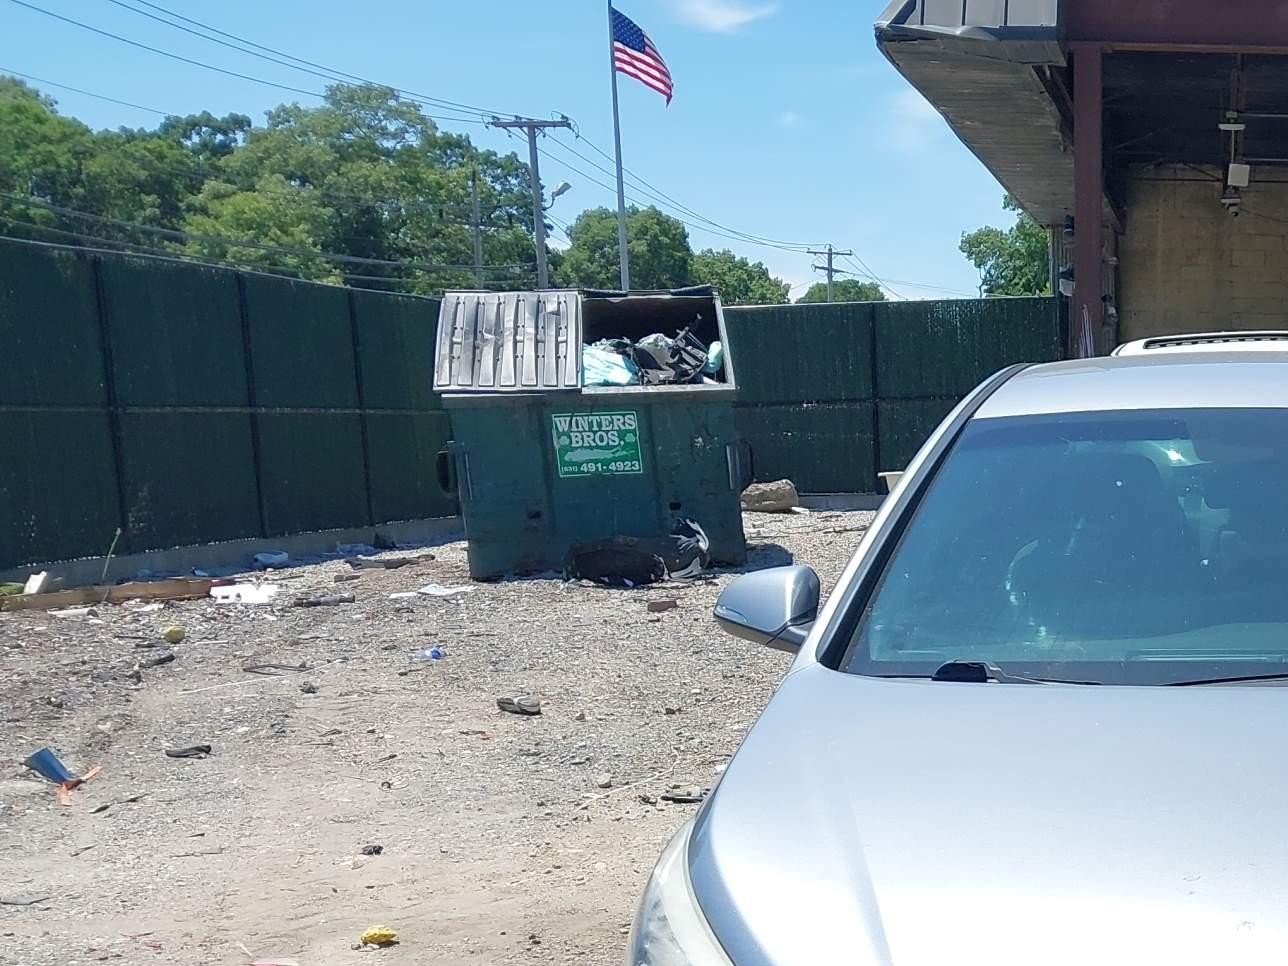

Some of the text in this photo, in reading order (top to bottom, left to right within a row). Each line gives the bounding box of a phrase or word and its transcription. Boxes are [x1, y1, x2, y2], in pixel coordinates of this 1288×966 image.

[554, 414, 636, 432] WINTERS
[569, 431, 625, 447] BROS.
[580, 461, 640, 473] 491-4923
